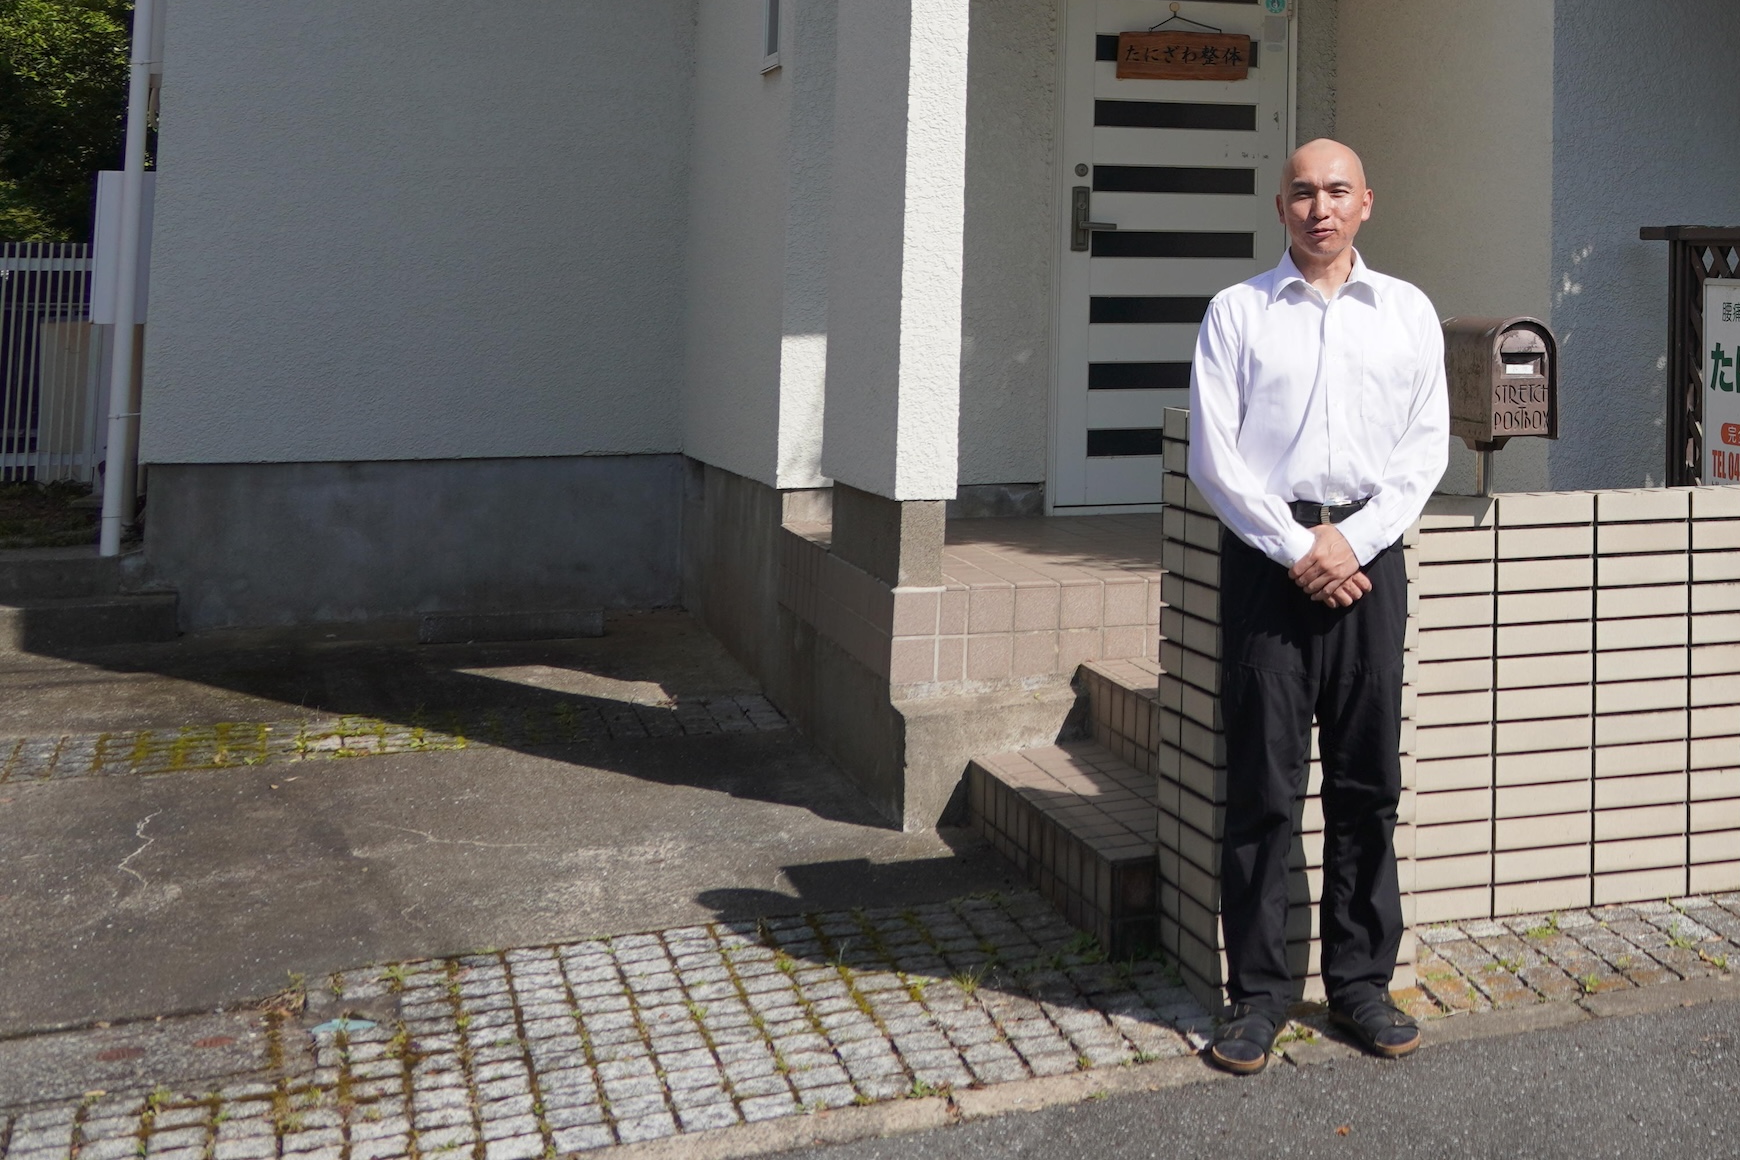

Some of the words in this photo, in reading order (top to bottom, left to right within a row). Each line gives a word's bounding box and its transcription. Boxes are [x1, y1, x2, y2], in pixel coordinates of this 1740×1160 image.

[1125, 45, 1243, 67] たにざわ整体
[1494, 384, 1549, 405] STRETCH
[1711, 449, 1726, 480] TEL
